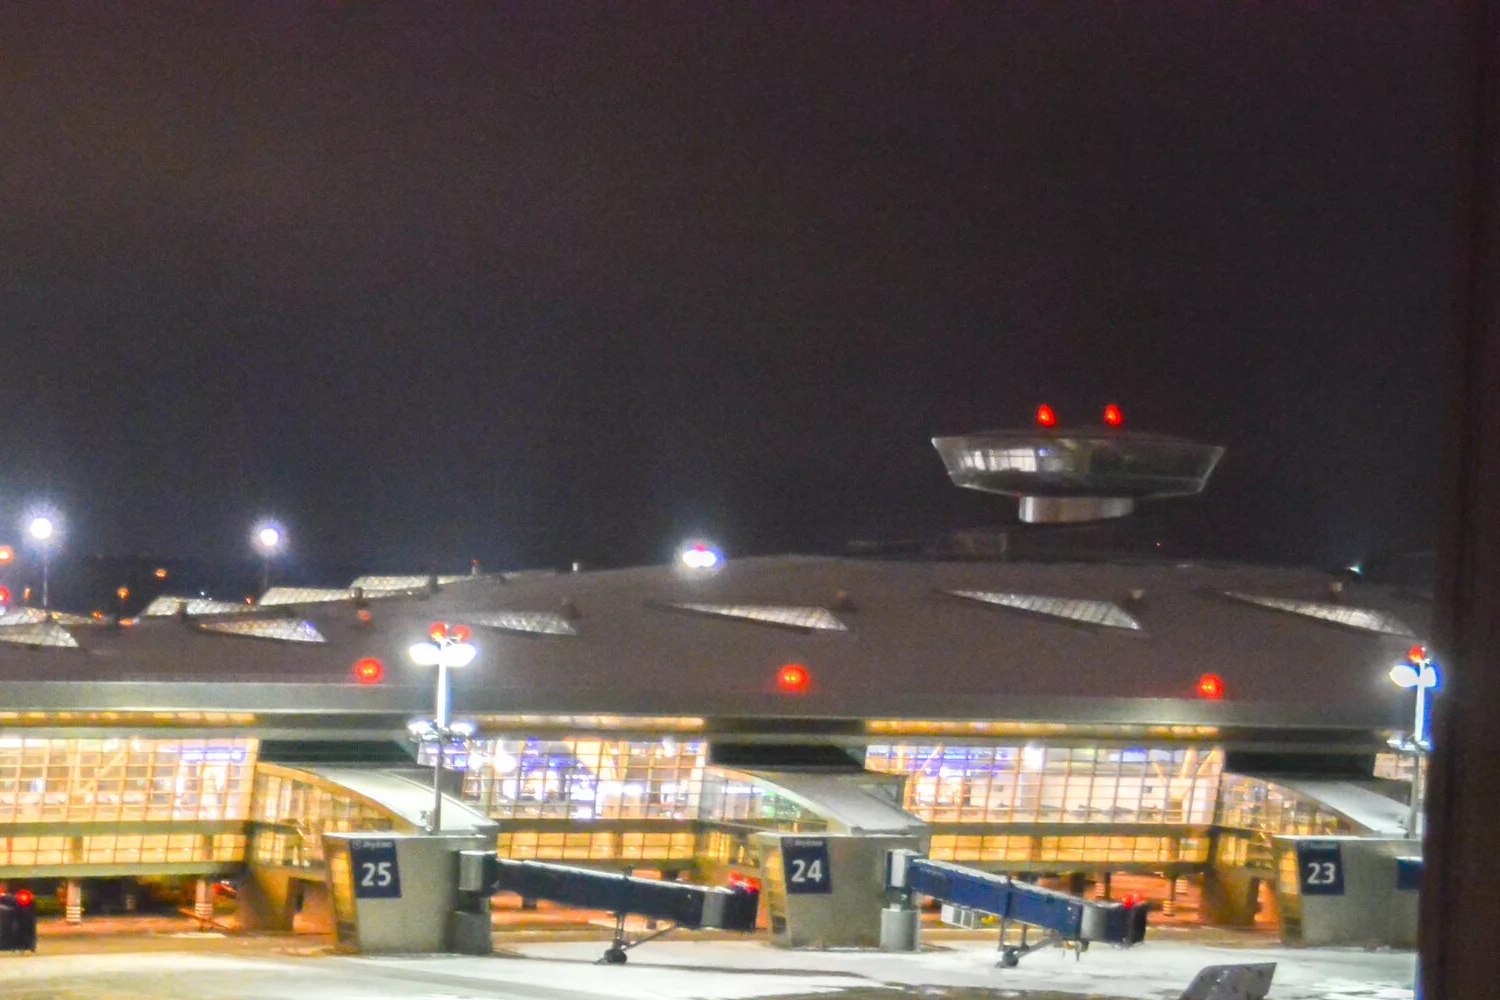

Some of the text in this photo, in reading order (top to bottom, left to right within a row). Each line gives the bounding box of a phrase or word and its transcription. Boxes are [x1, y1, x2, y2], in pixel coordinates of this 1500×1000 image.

[361, 862, 392, 886] 25
[791, 859, 822, 882] 24
[1307, 862, 1336, 885] 23
